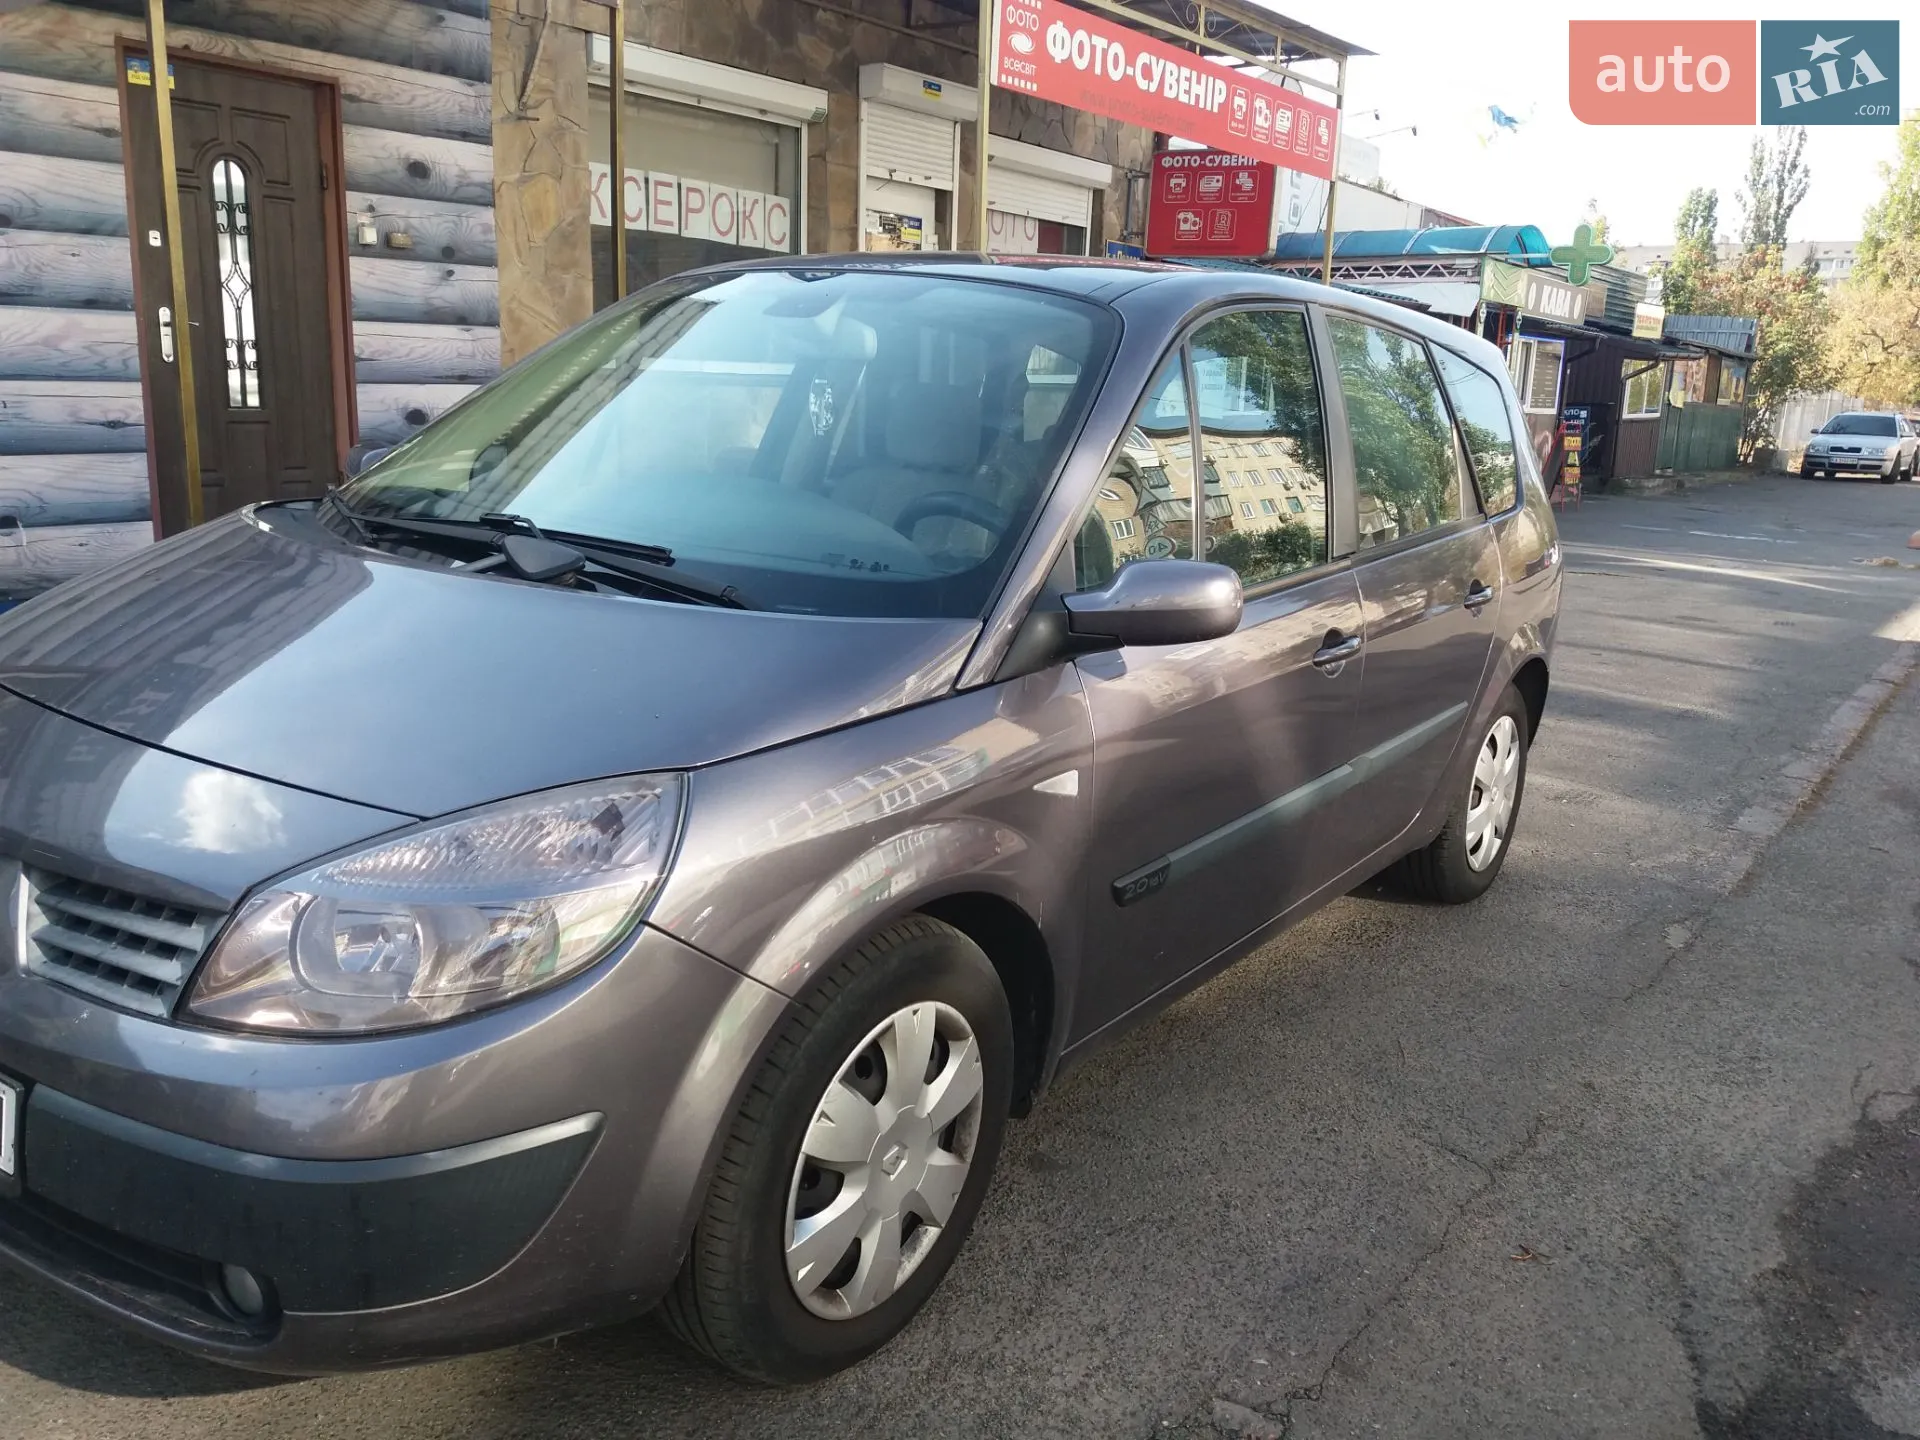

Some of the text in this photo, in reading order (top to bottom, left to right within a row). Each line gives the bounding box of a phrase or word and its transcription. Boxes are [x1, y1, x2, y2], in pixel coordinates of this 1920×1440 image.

[1006, 4, 1039, 32] ФОТО
[1046, 20, 1227, 113] ФОТО-СУВЕНІР
[590, 172, 787, 246] КСЕРОКС
[1540, 285, 1571, 318] КАВА
